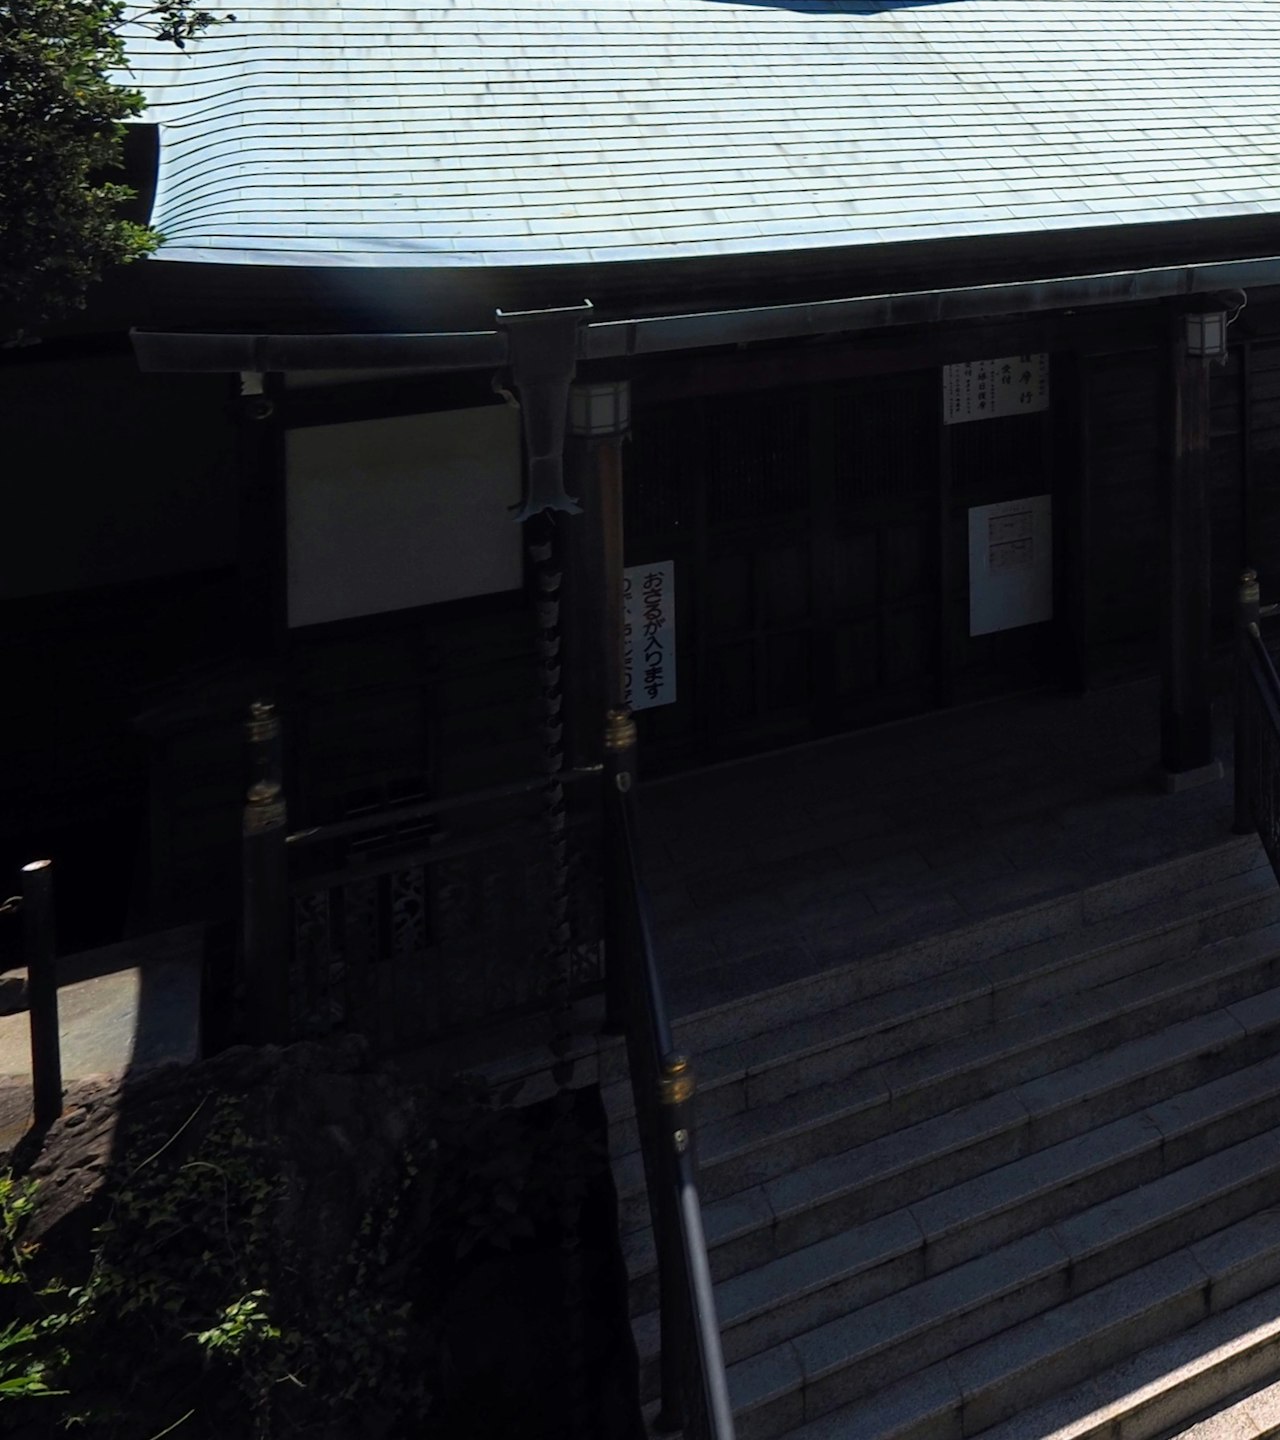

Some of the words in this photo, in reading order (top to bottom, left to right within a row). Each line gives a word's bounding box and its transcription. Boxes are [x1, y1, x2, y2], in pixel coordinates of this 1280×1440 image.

[642, 571, 666, 700] おさるが入ります
